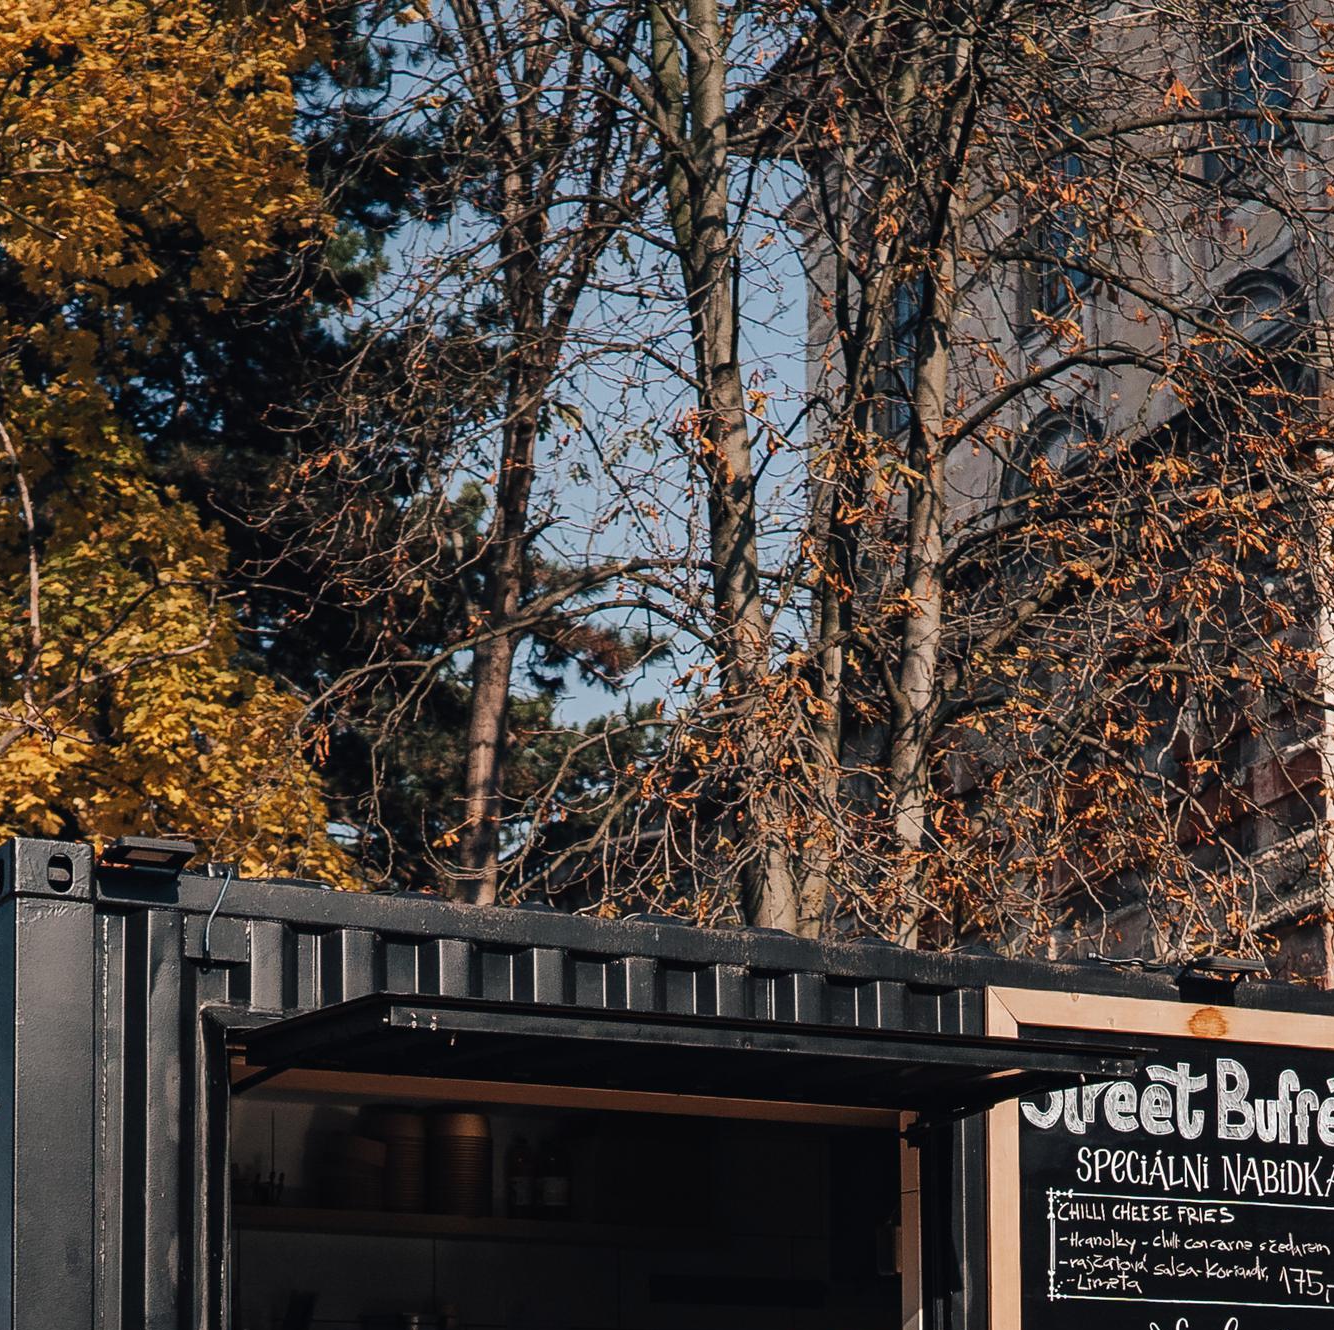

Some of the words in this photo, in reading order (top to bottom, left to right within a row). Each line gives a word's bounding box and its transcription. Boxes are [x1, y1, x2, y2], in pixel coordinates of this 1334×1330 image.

[1057, 1202, 1106, 1222] CHILLI
[1112, 1202, 1172, 1223] CHEESE
[1178, 1206, 1235, 1226] FRIES
